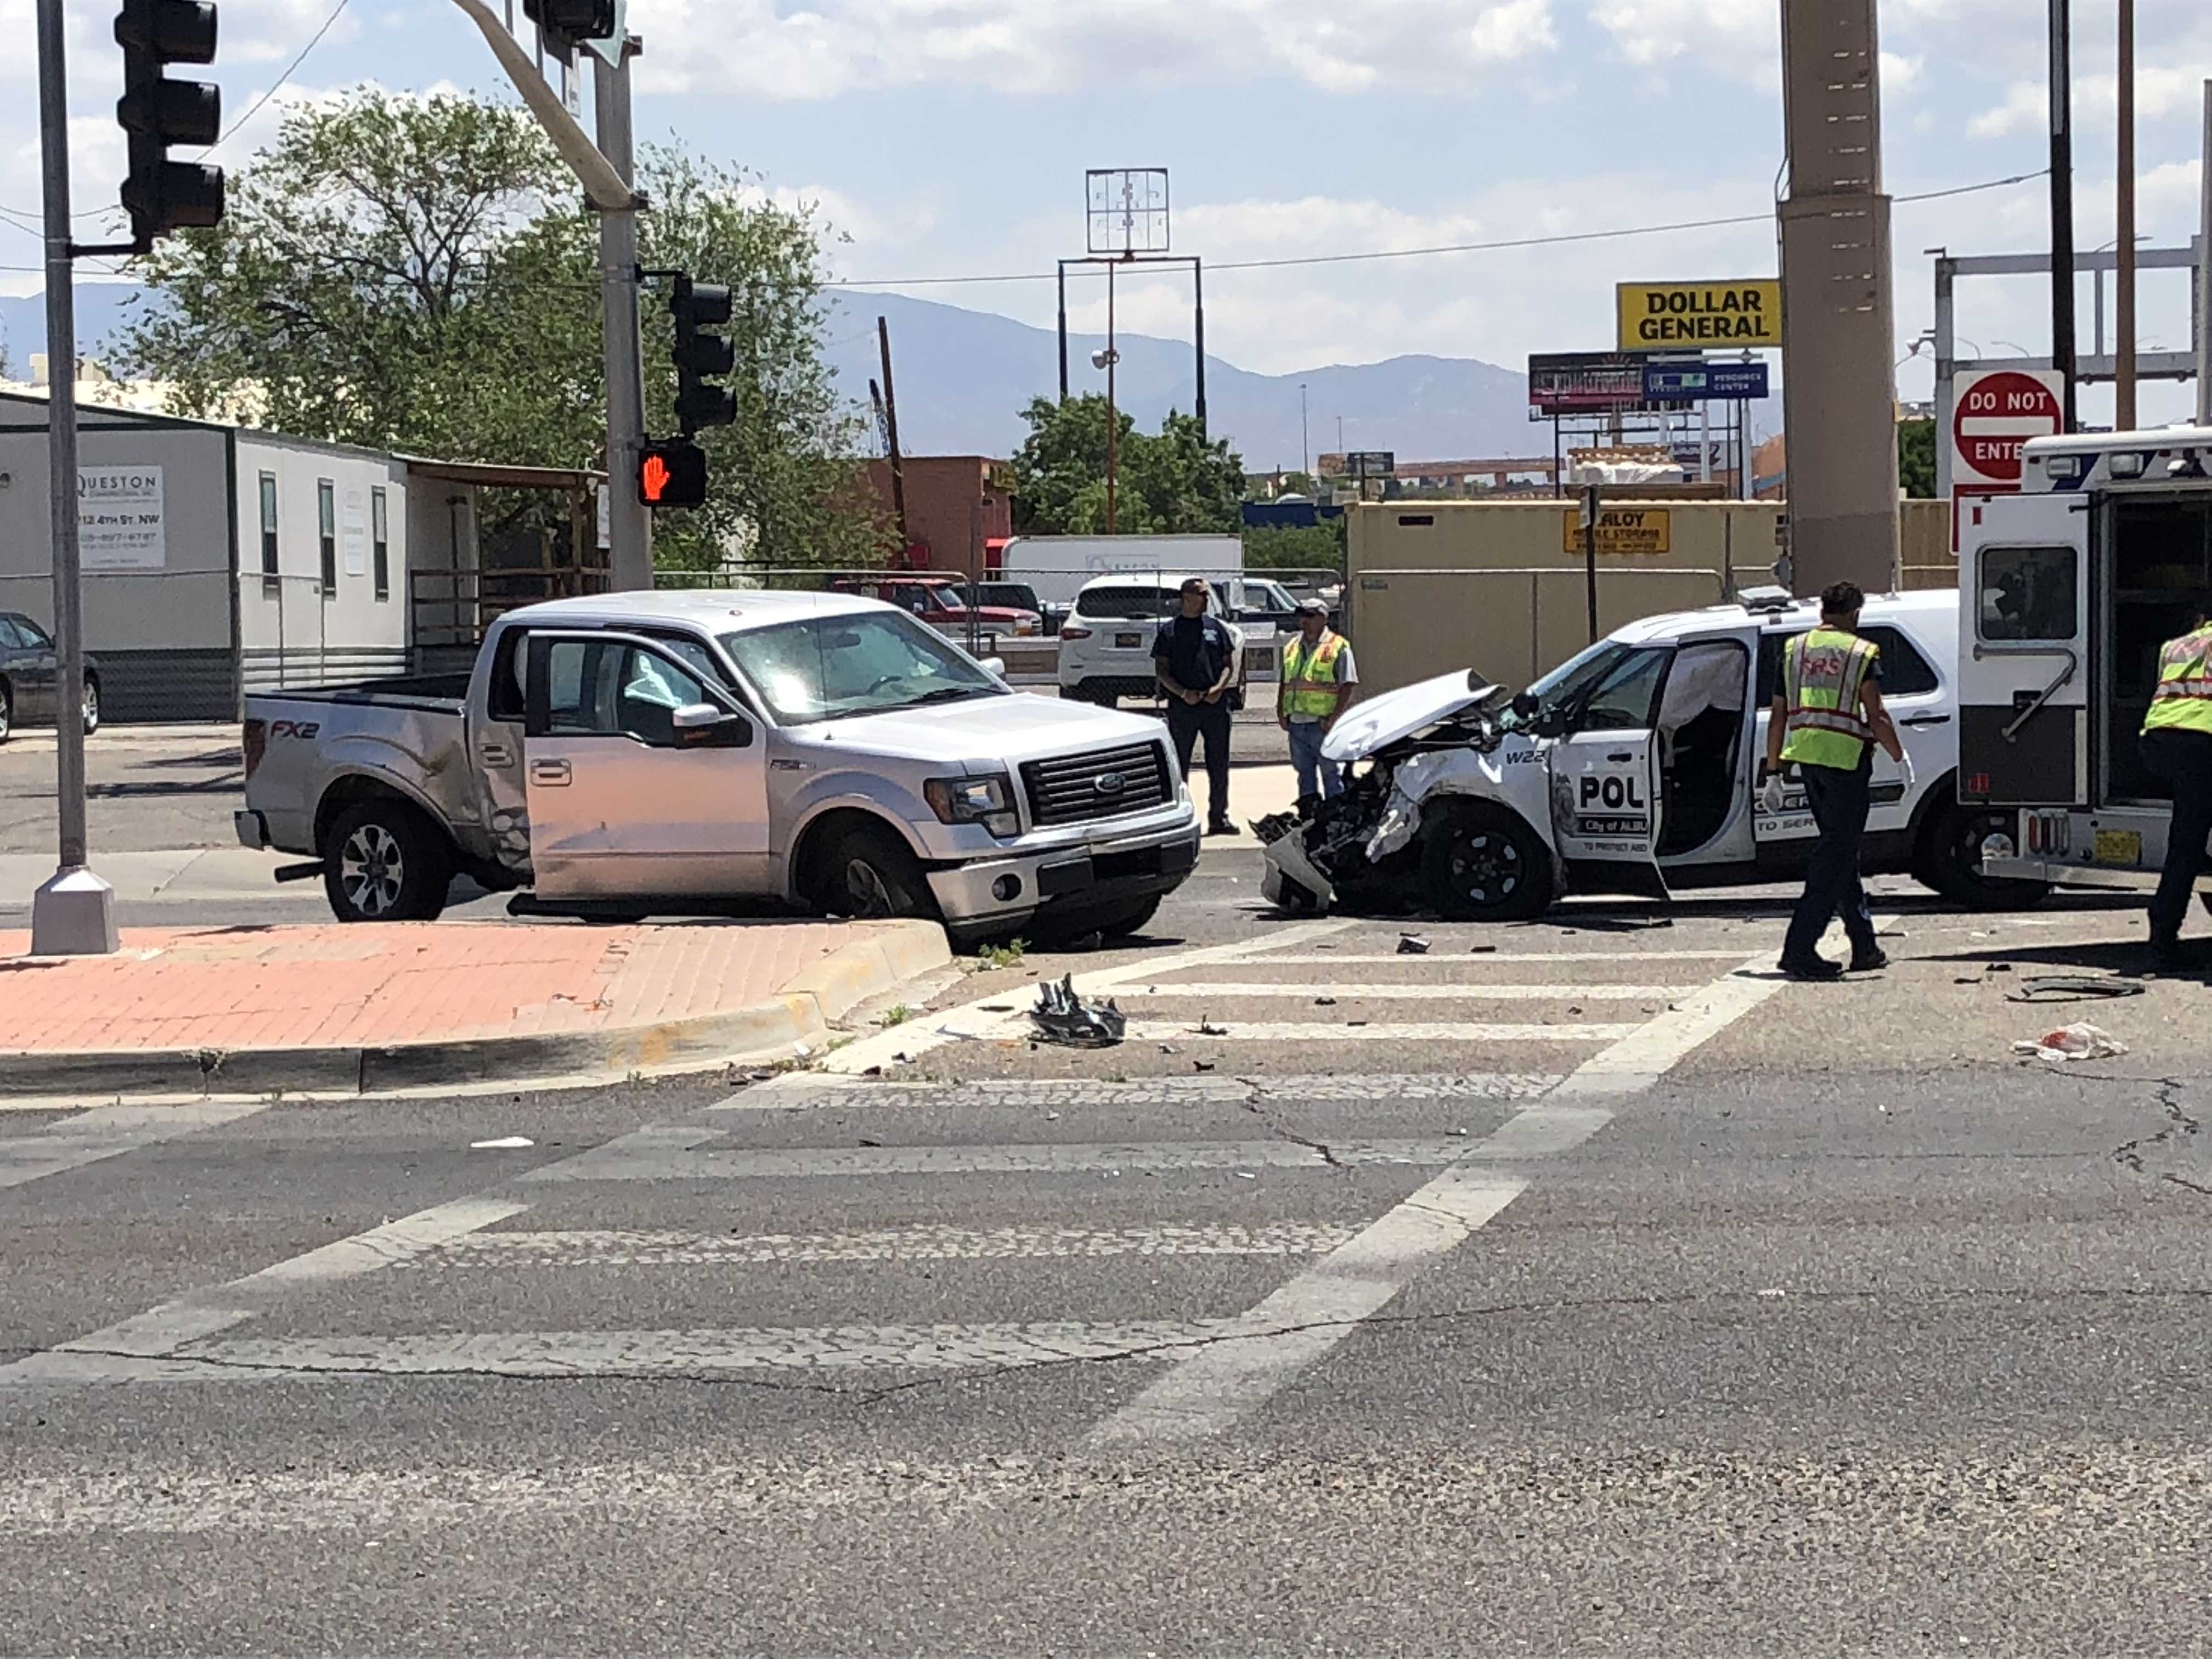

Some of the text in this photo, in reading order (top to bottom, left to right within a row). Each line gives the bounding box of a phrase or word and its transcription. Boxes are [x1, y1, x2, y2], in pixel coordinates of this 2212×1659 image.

[1646, 290, 1762, 313] DOLLAR
[1639, 315, 1770, 339] GENERAL
[1970, 392, 2047, 410] DO NOT
[1976, 442, 2024, 460] ENTE
[78, 514, 95, 525] 12
[138, 514, 159, 525] NW
[1597, 512, 1645, 527] ALOY
[270, 720, 320, 739] FX2
[1506, 750, 1545, 764] W22
[1580, 776, 1644, 809] POL
[1758, 818, 1814, 832] TO SER
